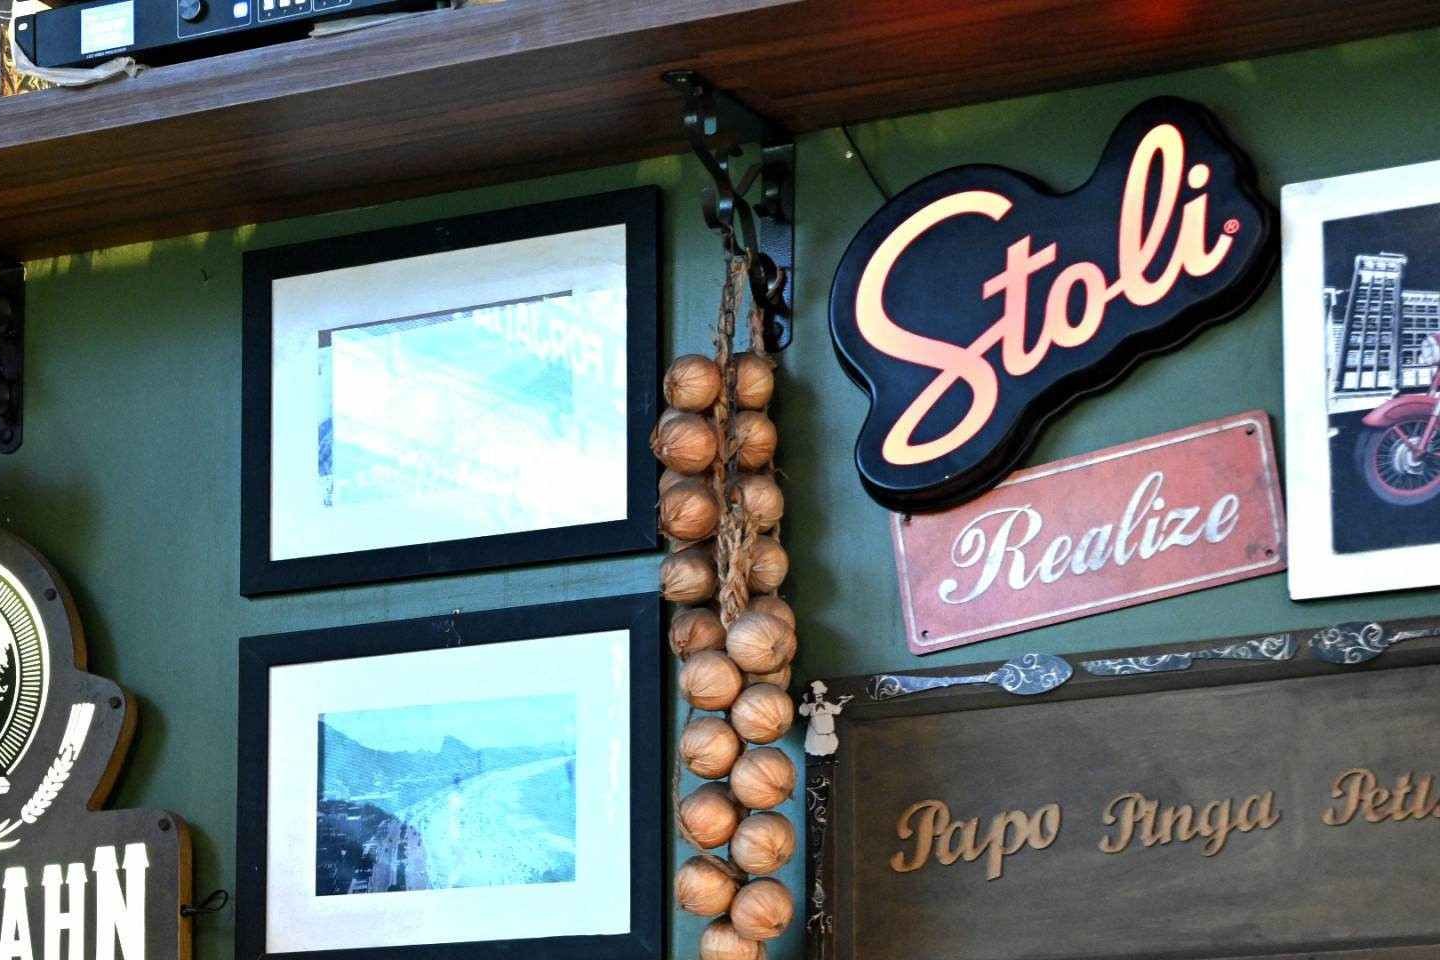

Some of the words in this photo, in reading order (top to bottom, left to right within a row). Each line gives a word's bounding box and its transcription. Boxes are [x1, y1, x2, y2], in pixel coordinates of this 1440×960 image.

[855, 123, 1234, 466] Stoli
[938, 470, 1241, 605] Realize
[890, 798, 1062, 881] Papo
[1098, 788, 1282, 857] Pinga
